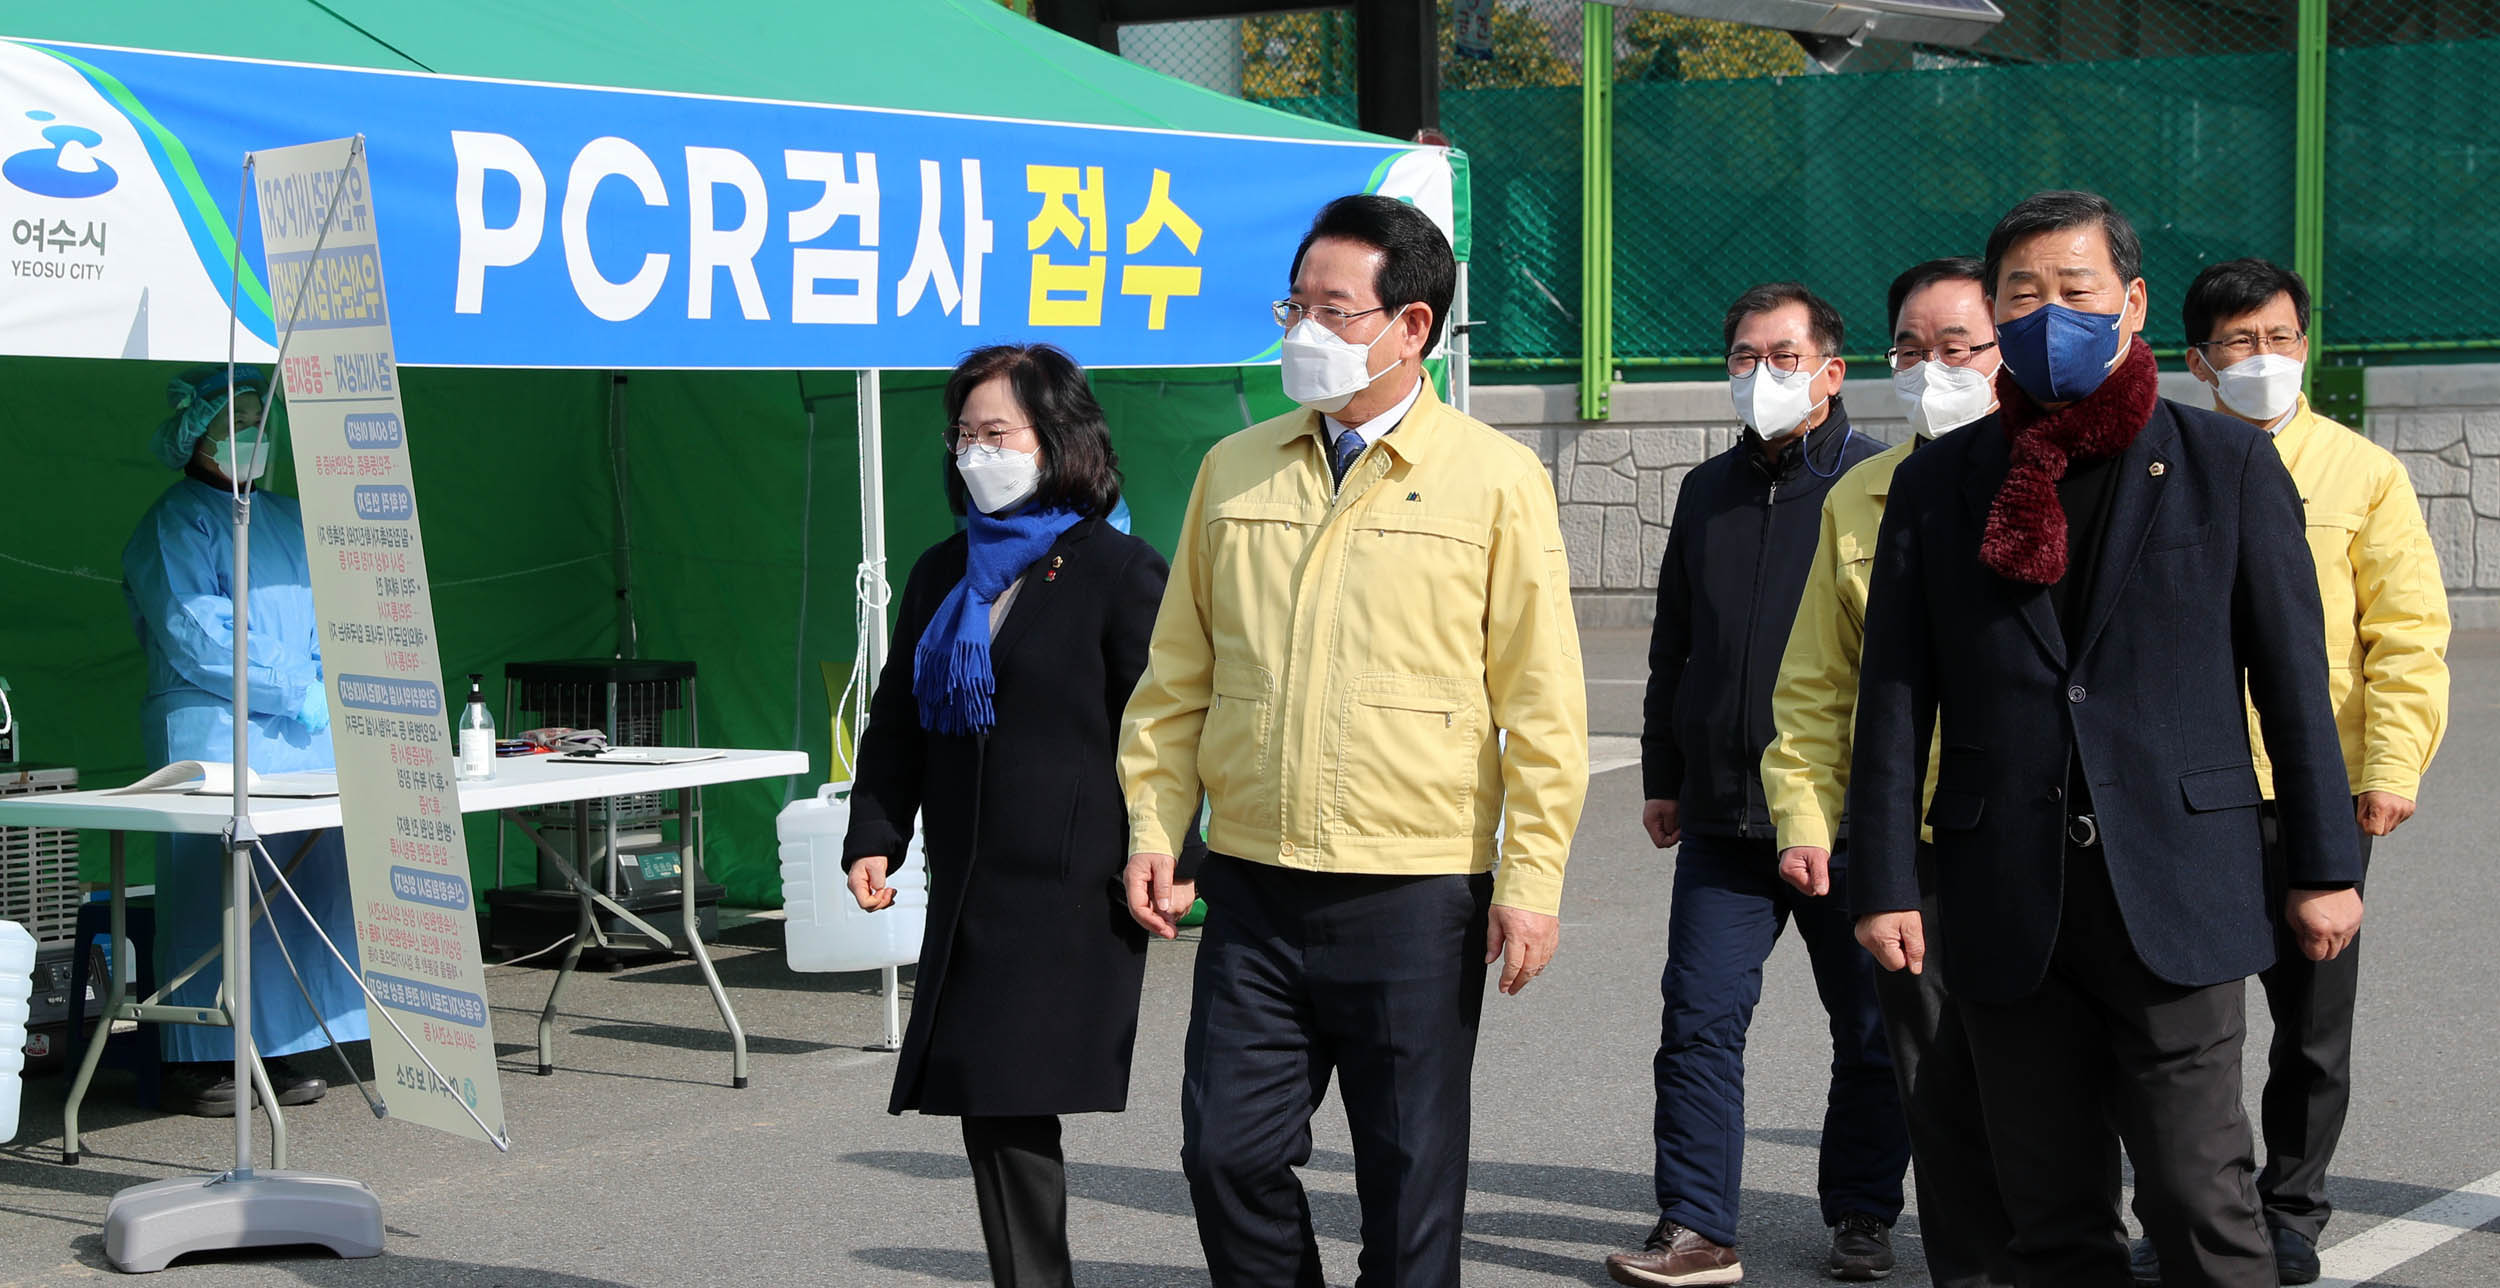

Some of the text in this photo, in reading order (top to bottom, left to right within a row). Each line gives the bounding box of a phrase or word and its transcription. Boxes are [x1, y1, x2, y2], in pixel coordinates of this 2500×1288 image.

[12, 218, 107, 256] 여수시
[451, 130, 1203, 330] PCR검사 접수
[11, 259, 105, 281] YEOSU CITY
